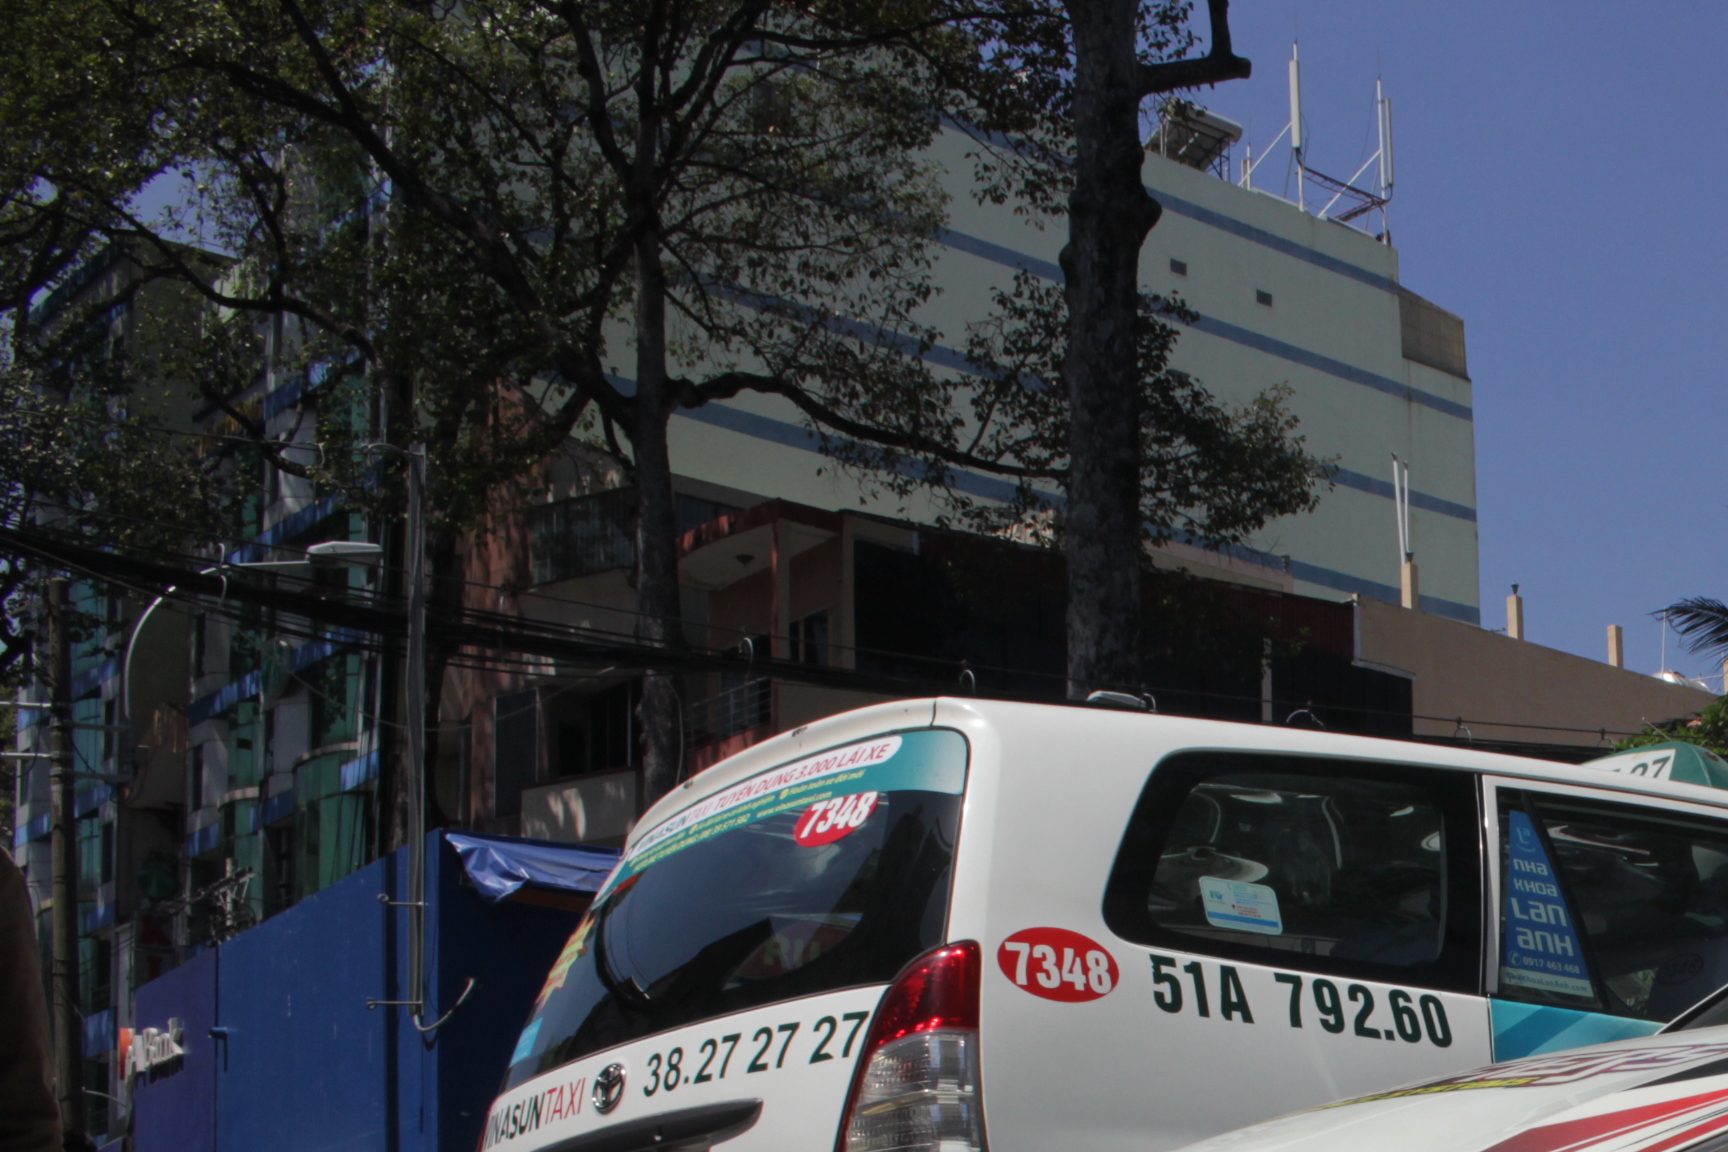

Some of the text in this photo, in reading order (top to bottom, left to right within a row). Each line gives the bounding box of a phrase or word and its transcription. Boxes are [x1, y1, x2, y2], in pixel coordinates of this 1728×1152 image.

[864, 743, 892, 760] XE
[799, 790, 879, 839] 7348
[1004, 941, 1114, 994] 7348
[1150, 953, 1454, 1049] 51A 792.60
[643, 1033, 741, 1097] 38.27
[746, 1021, 800, 1075] 27
[809, 1010, 870, 1065] 27
